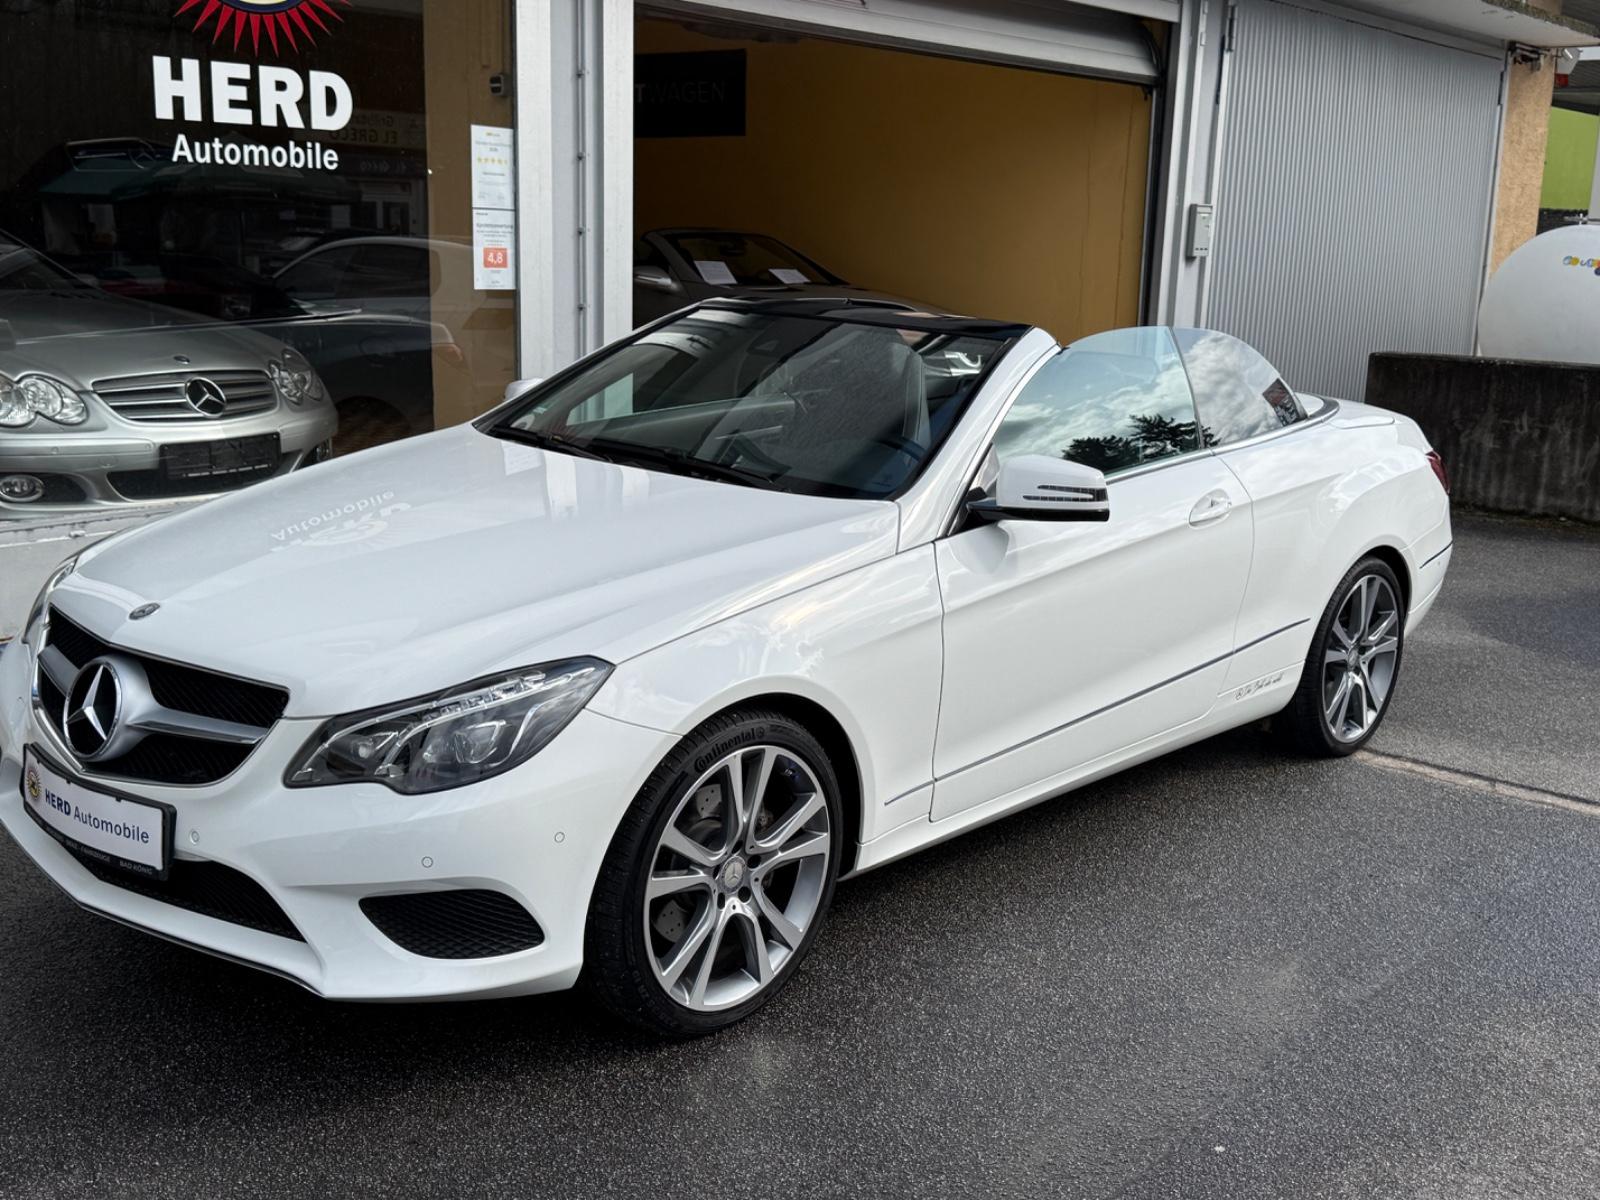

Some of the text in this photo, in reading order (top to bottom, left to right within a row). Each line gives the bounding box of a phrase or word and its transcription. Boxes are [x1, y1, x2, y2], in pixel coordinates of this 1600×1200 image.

[153, 55, 353, 131] HERD
[172, 133, 339, 171] Automobile
[487, 251, 504, 264] 4,8
[694, 727, 755, 773] Continental
[45, 788, 71, 816] HERD
[74, 806, 150, 844] Automobile
